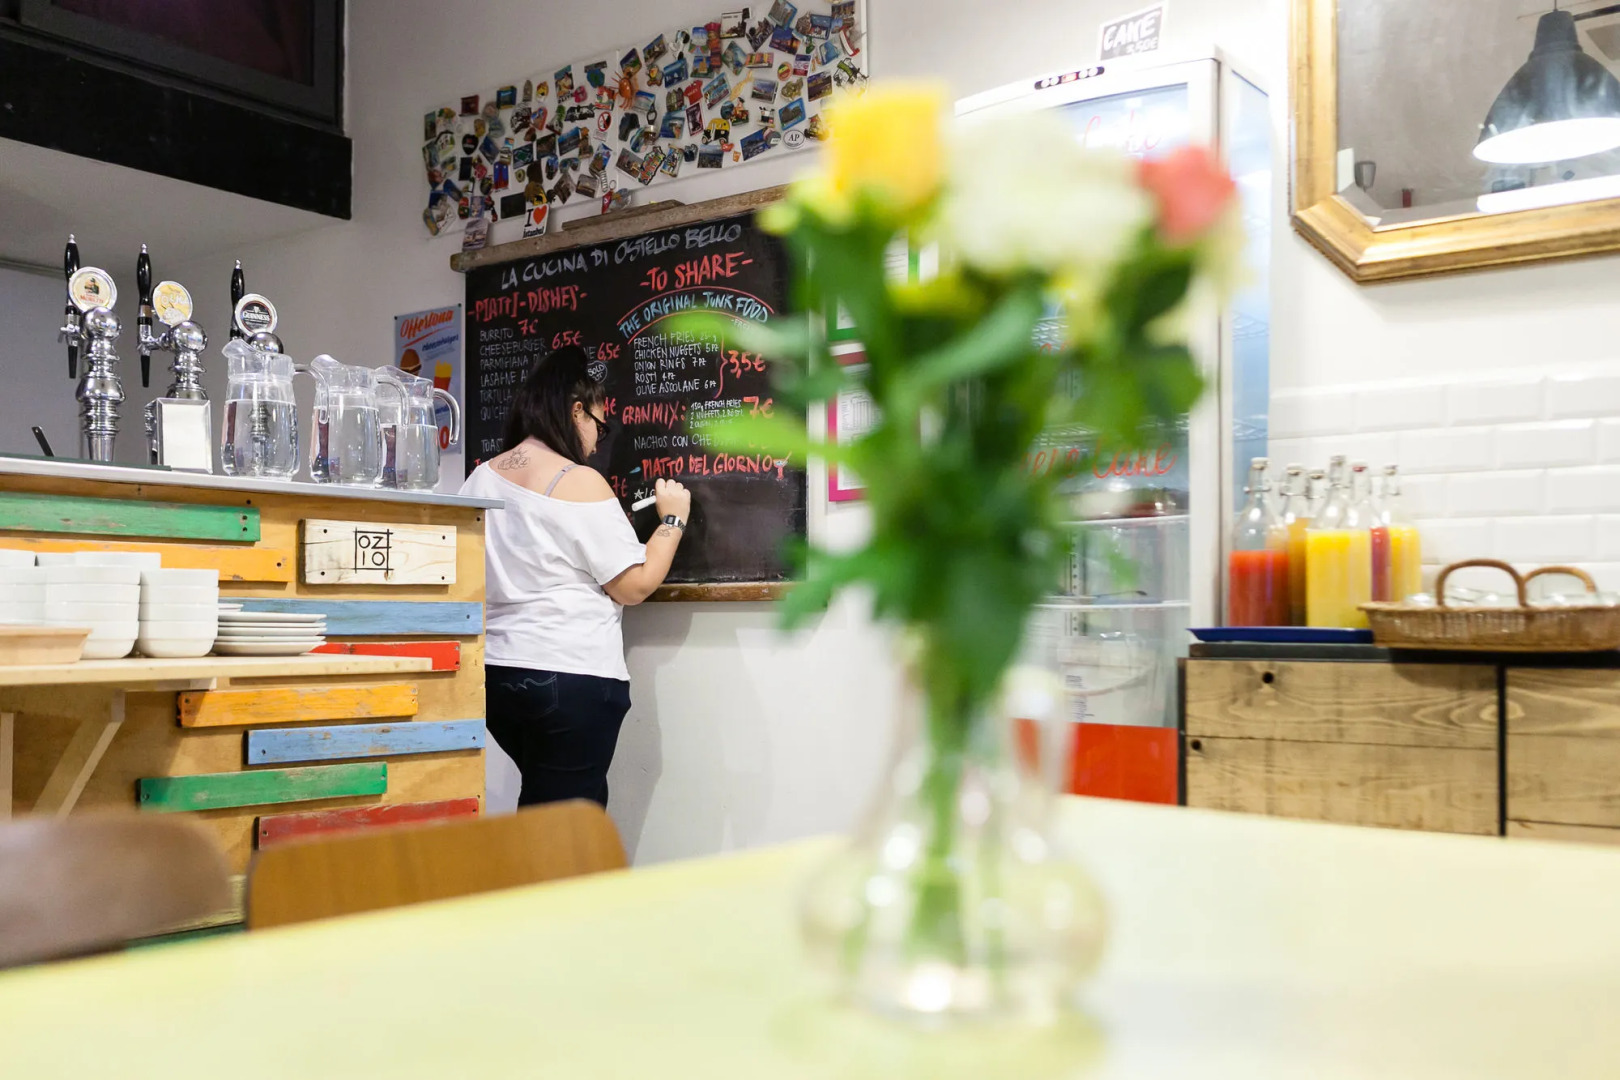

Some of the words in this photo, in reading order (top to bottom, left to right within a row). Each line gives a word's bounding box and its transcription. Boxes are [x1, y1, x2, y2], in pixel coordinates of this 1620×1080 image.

[1104, 11, 1161, 51] CAKE
[501, 267, 518, 290] LA
[523, 253, 588, 281] CUCINA
[591, 248, 608, 267] DI
[614, 234, 680, 264] OSTELLO
[685, 224, 741, 249] BELLO
[619, 313, 640, 339] THE
[643, 294, 697, 321] ORIGINAL
[737, 297, 768, 322] FOOD
[480, 328, 513, 341] BURRITO
[633, 332, 668, 350] FRENCH
[670, 330, 695, 346] FRIES
[480, 338, 546, 356] CHEESEBURGER
[634, 346, 668, 361] CHICKEN
[669, 342, 702, 358] NUGGETS
[587, 364, 605, 377] SOLD
[634, 360, 656, 372] ONION
[660, 356, 686, 370] RINGS
[636, 382, 656, 396] OLIVE
[659, 378, 700, 394] ASCOLANE
[743, 395, 773, 420] 7€
[634, 435, 667, 449] NACHOS
[671, 434, 688, 448] CON
[642, 456, 684, 481] PIATTO
[689, 454, 710, 477] DEL
[713, 452, 773, 476] GIORNO
